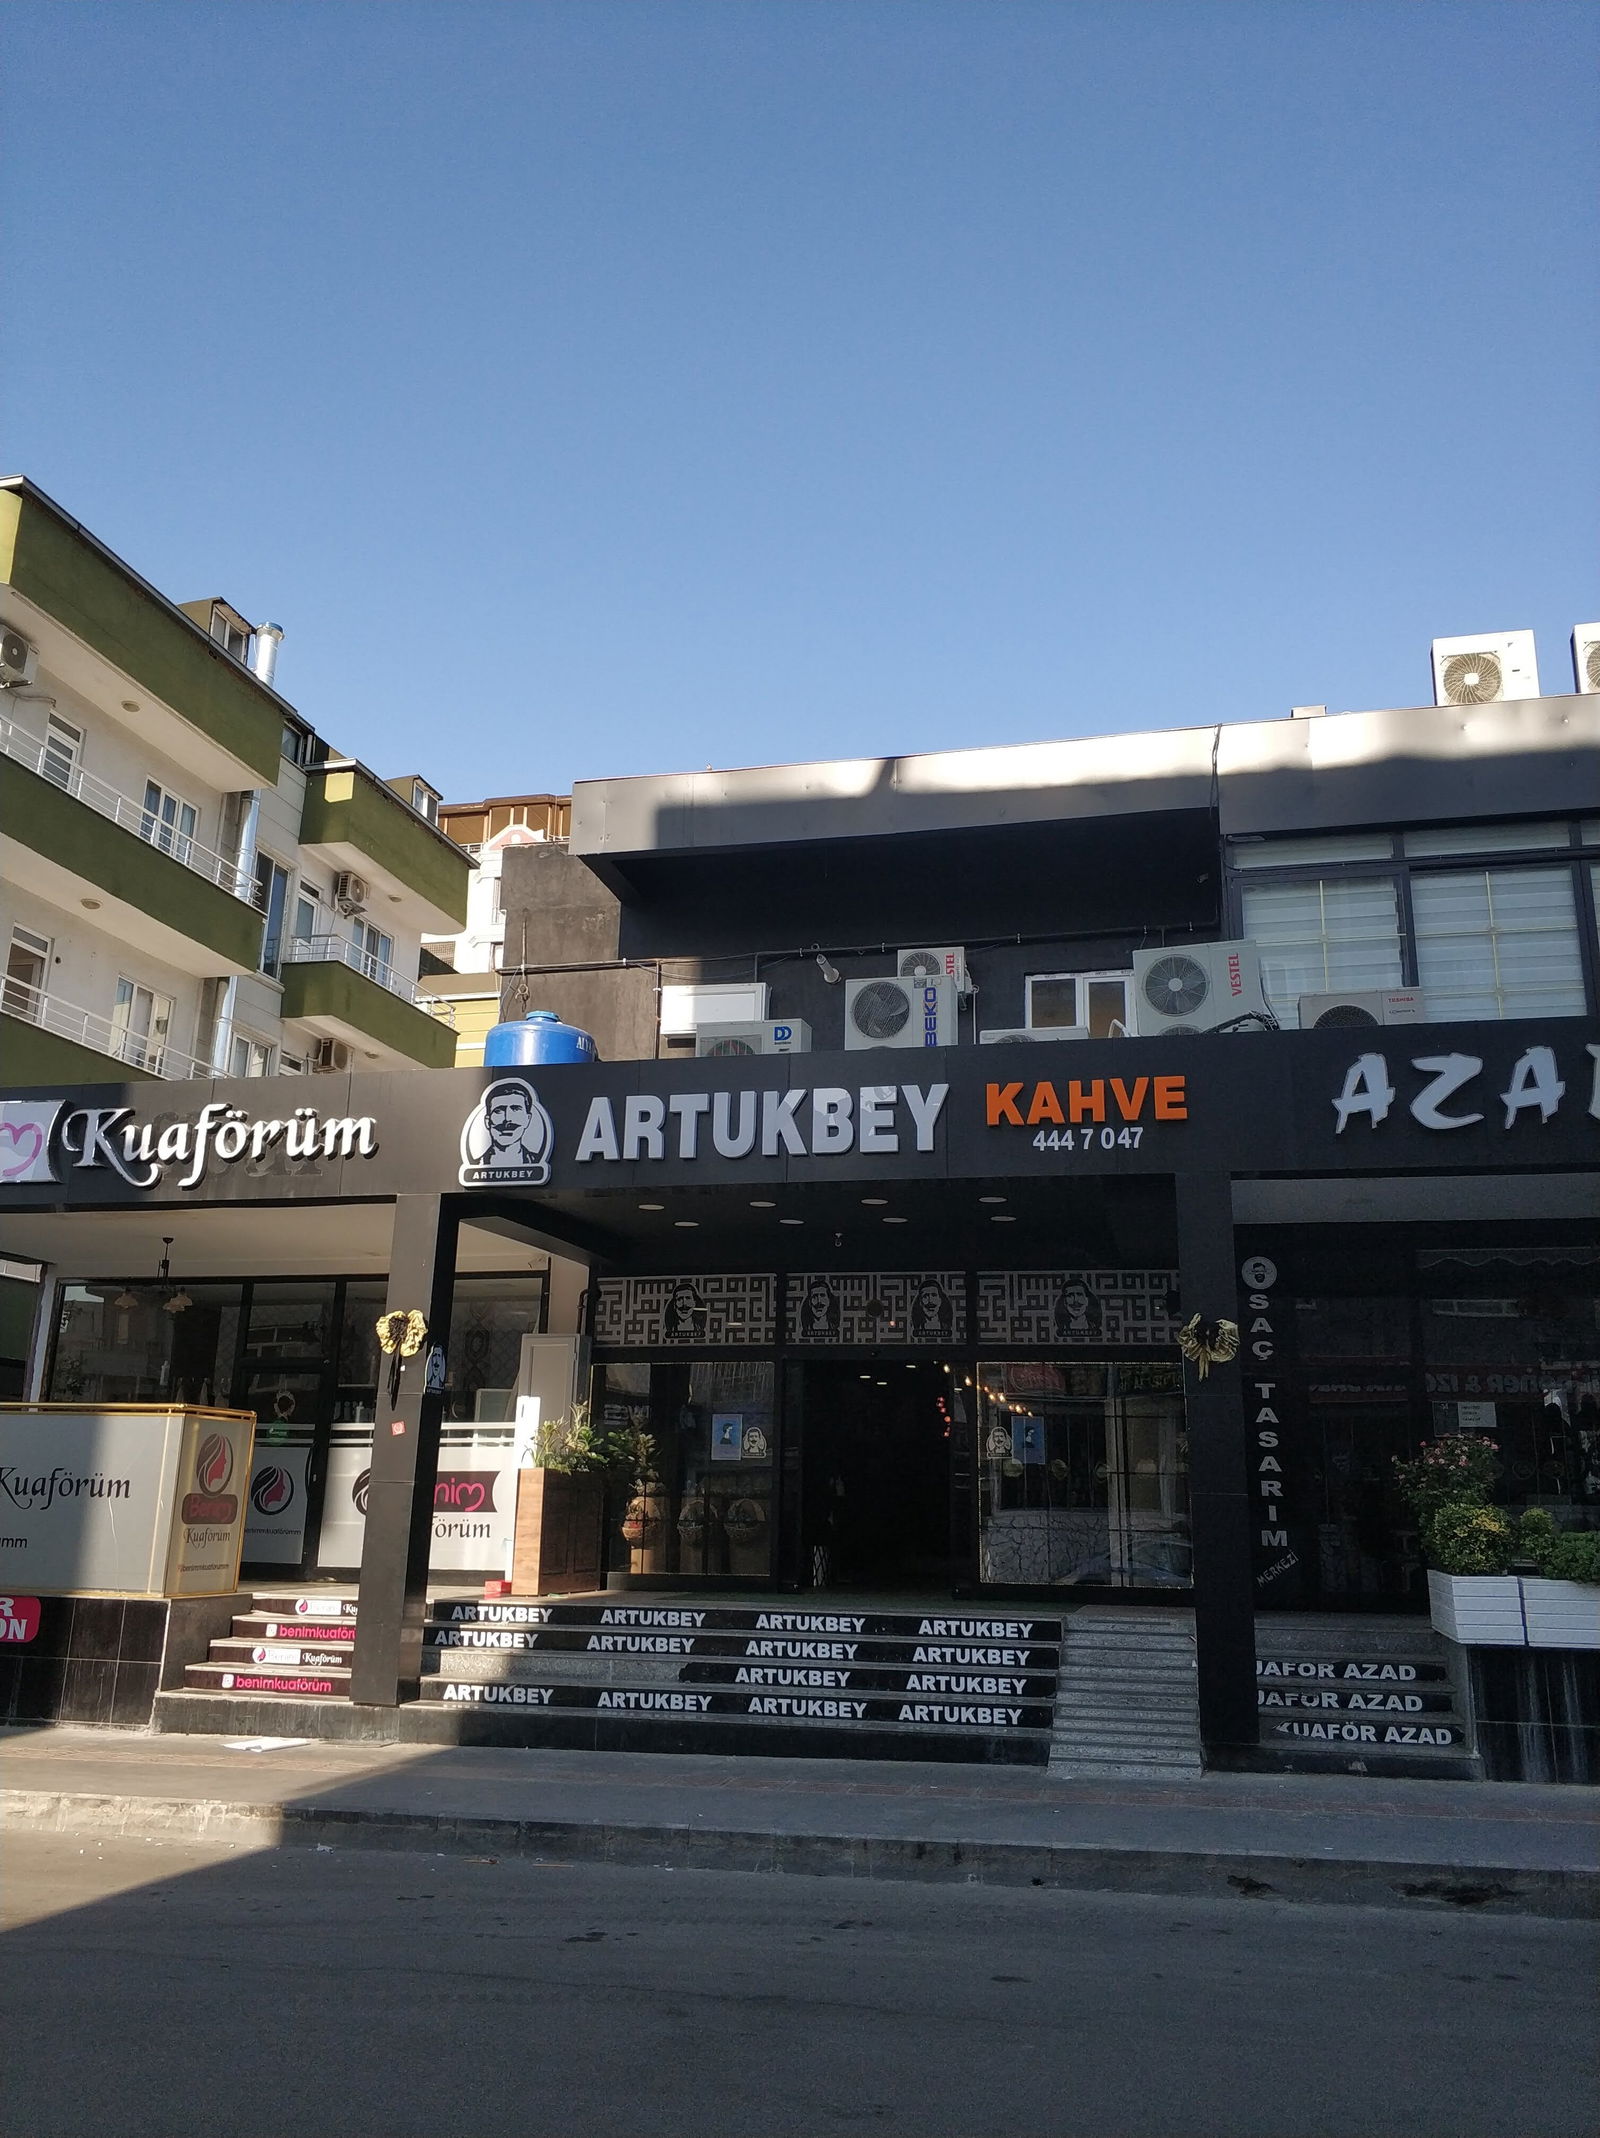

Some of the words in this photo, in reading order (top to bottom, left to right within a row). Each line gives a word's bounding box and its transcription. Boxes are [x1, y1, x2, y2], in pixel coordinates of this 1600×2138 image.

[1228, 953, 1242, 997] VESTEL
[924, 987, 937, 1047] BEKO
[575, 1083, 949, 1161] ARTUKBEY
[987, 1075, 1188, 1126] KAHVE
[63, 1102, 376, 1187] Kuaförüm
[1032, 1130, 1075, 1152] 444
[1080, 1129, 1094, 1150] 7
[1101, 1127, 1144, 1149] 047
[472, 1170, 533, 1180] ARTUKBEY
[1248, 1293, 1274, 1361] SAÇ
[1255, 1382, 1288, 1547] TASARIM
[432, 1515, 491, 1538] örüm
[451, 1606, 553, 1623] ARTUKBEY
[600, 1609, 705, 1627] ARTUKBEY
[756, 1614, 866, 1633] ARTUKBEY
[918, 1619, 1033, 1639] ARTUKBEY
[434, 1630, 539, 1648] ARTUKBEY
[587, 1635, 695, 1653] ARTUKBEY
[746, 1640, 859, 1660] ARTUKBEY
[912, 1646, 1030, 1666] ARTUKBEY
[236, 1675, 332, 1693] benimkuaförüm
[735, 1667, 850, 1687] ARTUKBEY
[906, 1674, 1027, 1695] ARTUKBEY
[1344, 1663, 1416, 1681] AZAD
[443, 1683, 554, 1704] ARTUKBEY
[597, 1691, 712, 1712] ARTUKBEY
[748, 1696, 868, 1719] ARTUKBEY
[899, 1704, 1022, 1725] ARTUKBEY
[1348, 1694, 1423, 1712] AZAD
[1384, 1726, 1451, 1745] AZAD
